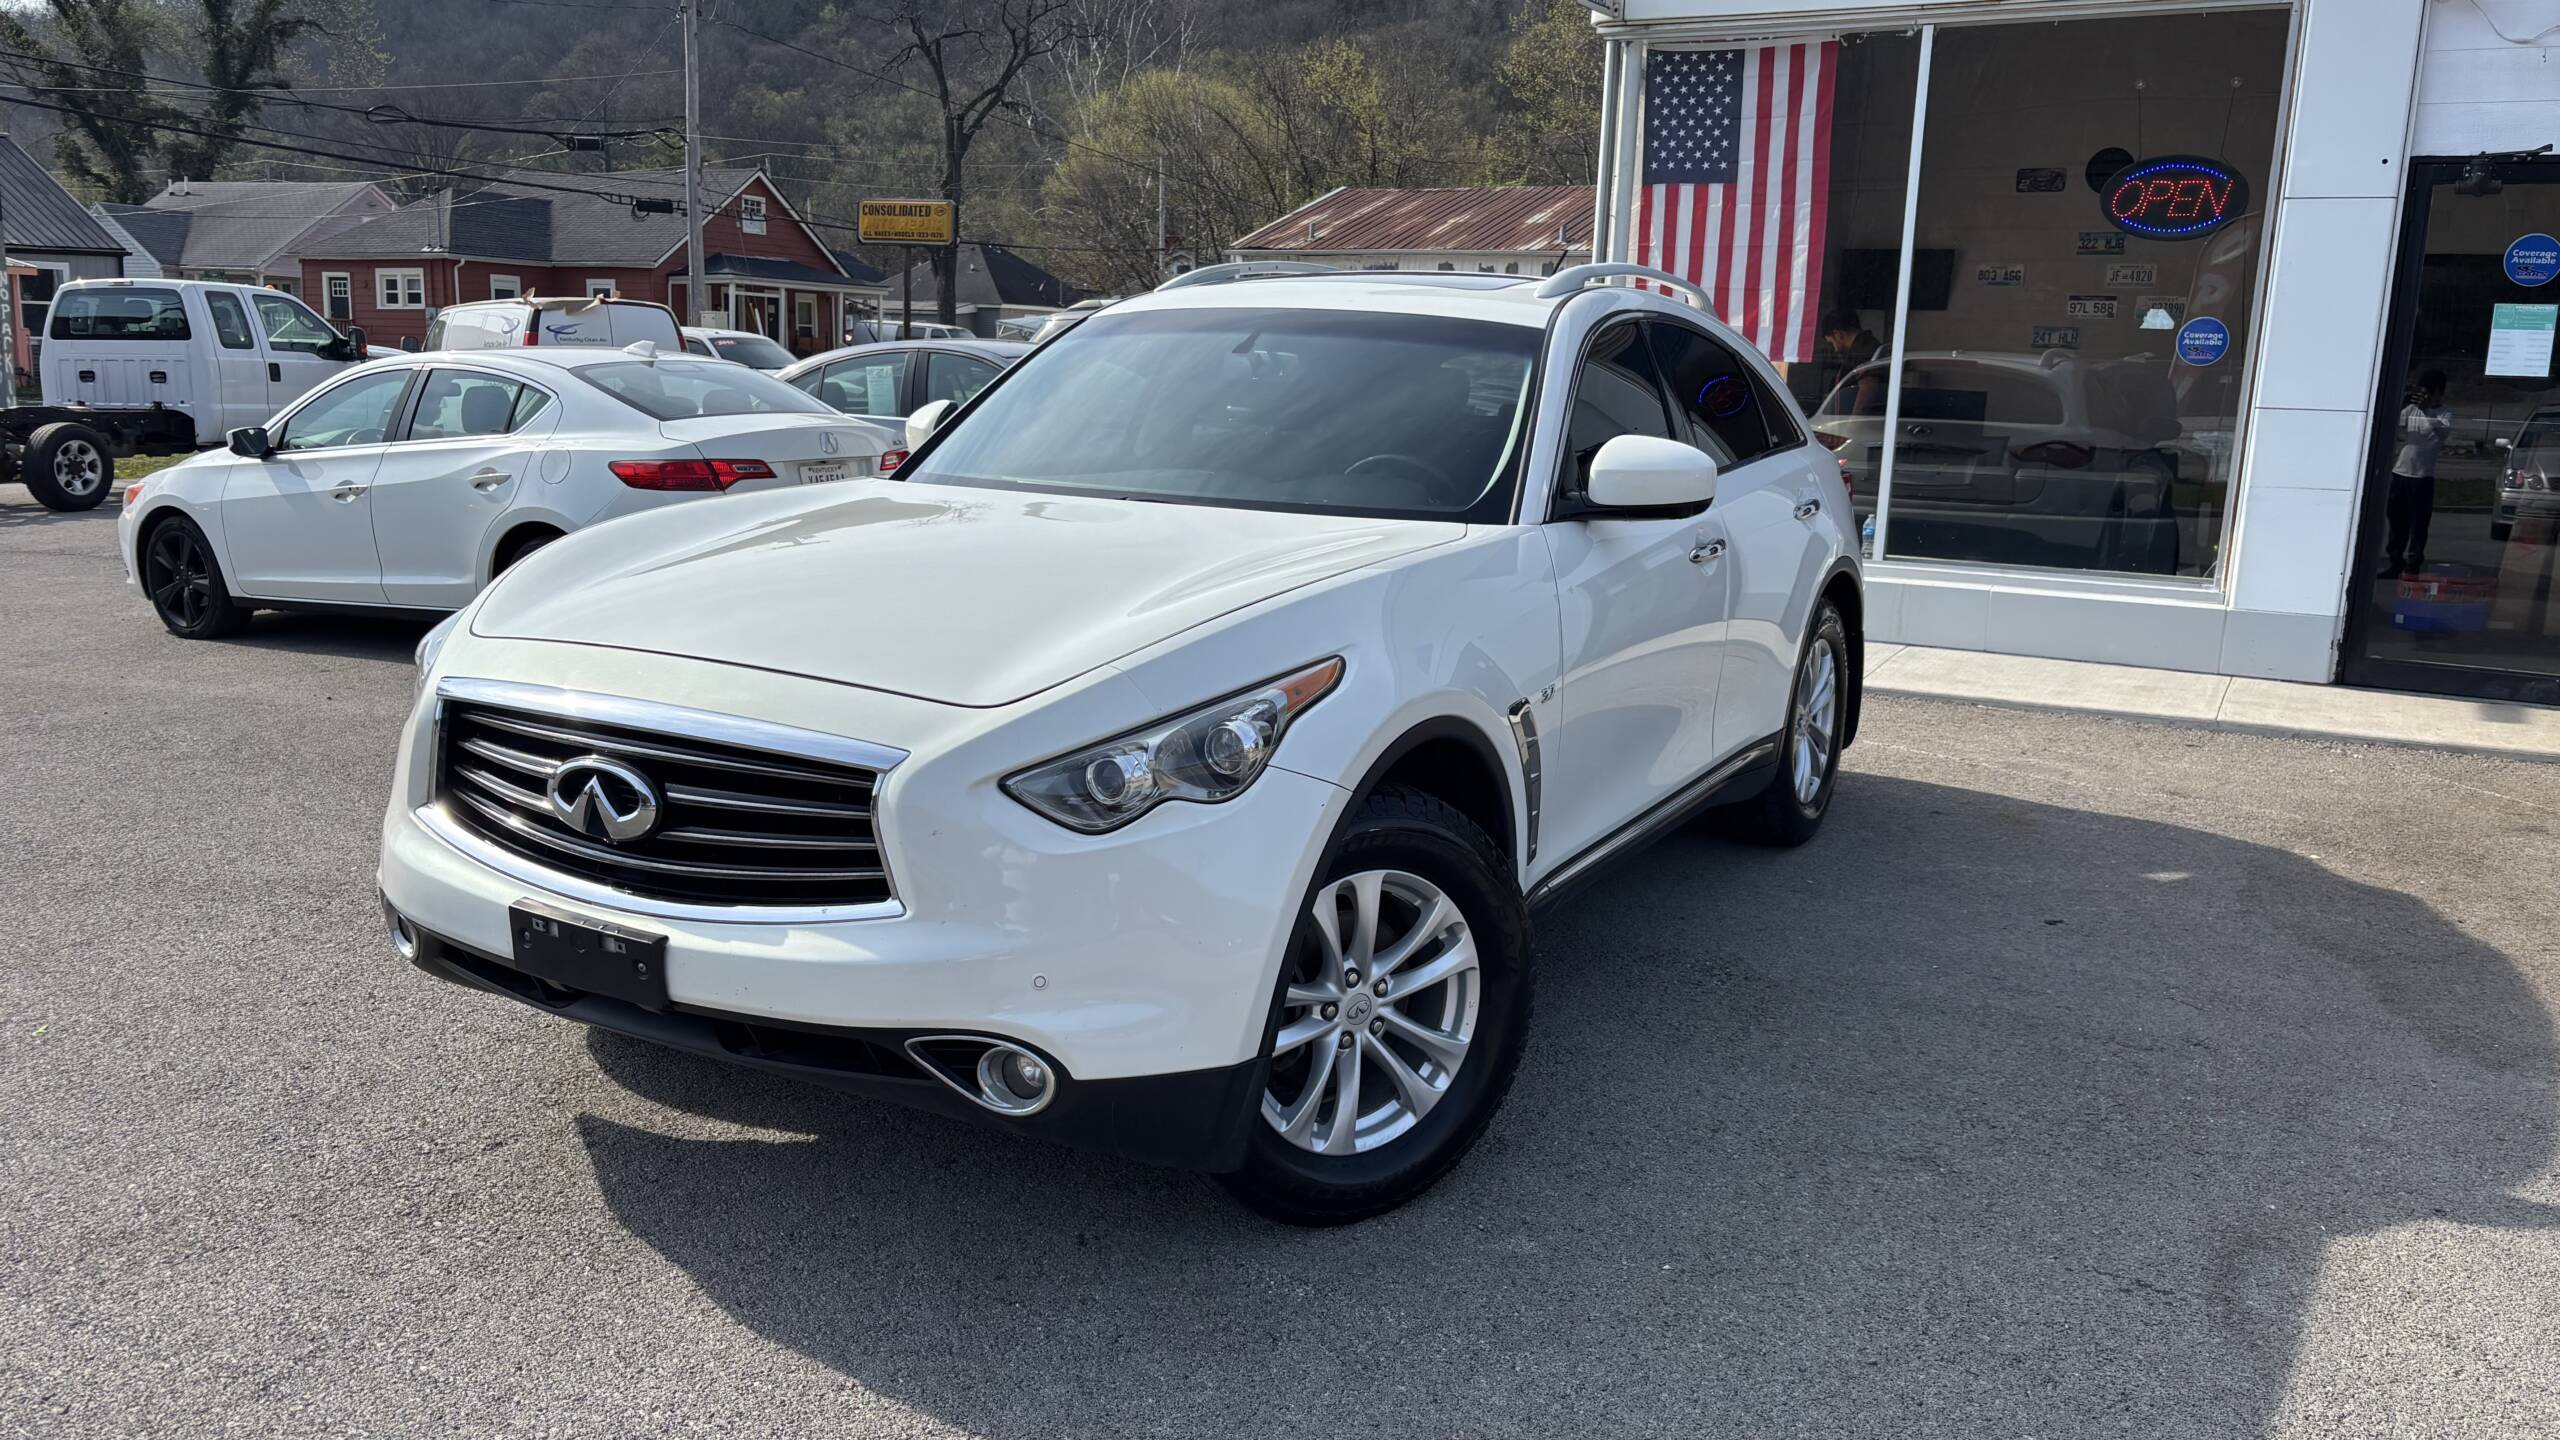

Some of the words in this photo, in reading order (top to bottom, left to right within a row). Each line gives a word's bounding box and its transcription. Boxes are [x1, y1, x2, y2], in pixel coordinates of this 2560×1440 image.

[2111, 179, 2234, 218] OPEN
[862, 204, 932, 217] CONSOLIDATED
[2078, 238, 2098, 249] 322
[2512, 249, 2558, 259] Coverage
[2511, 256, 2557, 264] Available
[2069, 302, 2089, 314] 97L
[2093, 302, 2114, 314] 588
[559, 336, 583, 344] Kentucky
[2184, 331, 2224, 341] Coverage
[2183, 338, 2223, 346] Available
